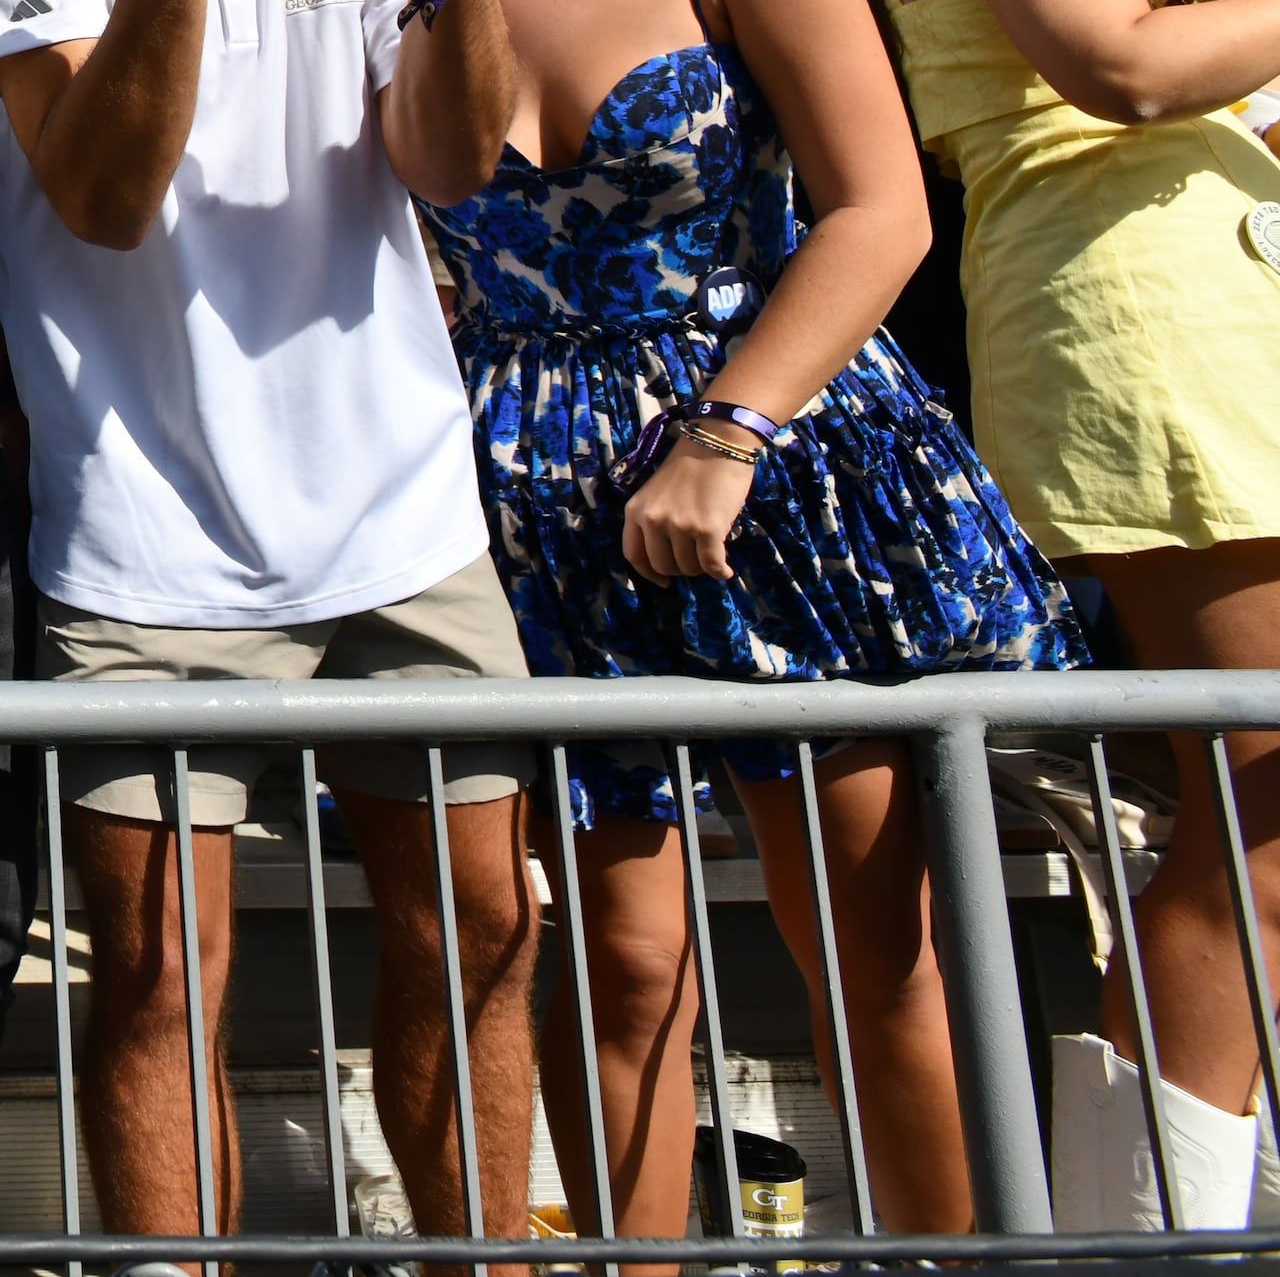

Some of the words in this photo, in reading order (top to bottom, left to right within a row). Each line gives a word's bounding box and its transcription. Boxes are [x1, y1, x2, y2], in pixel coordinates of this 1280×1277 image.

[752, 1188, 788, 1211] GT
[742, 1209, 778, 1222] EORGIA
[781, 1213, 800, 1222] TECH
